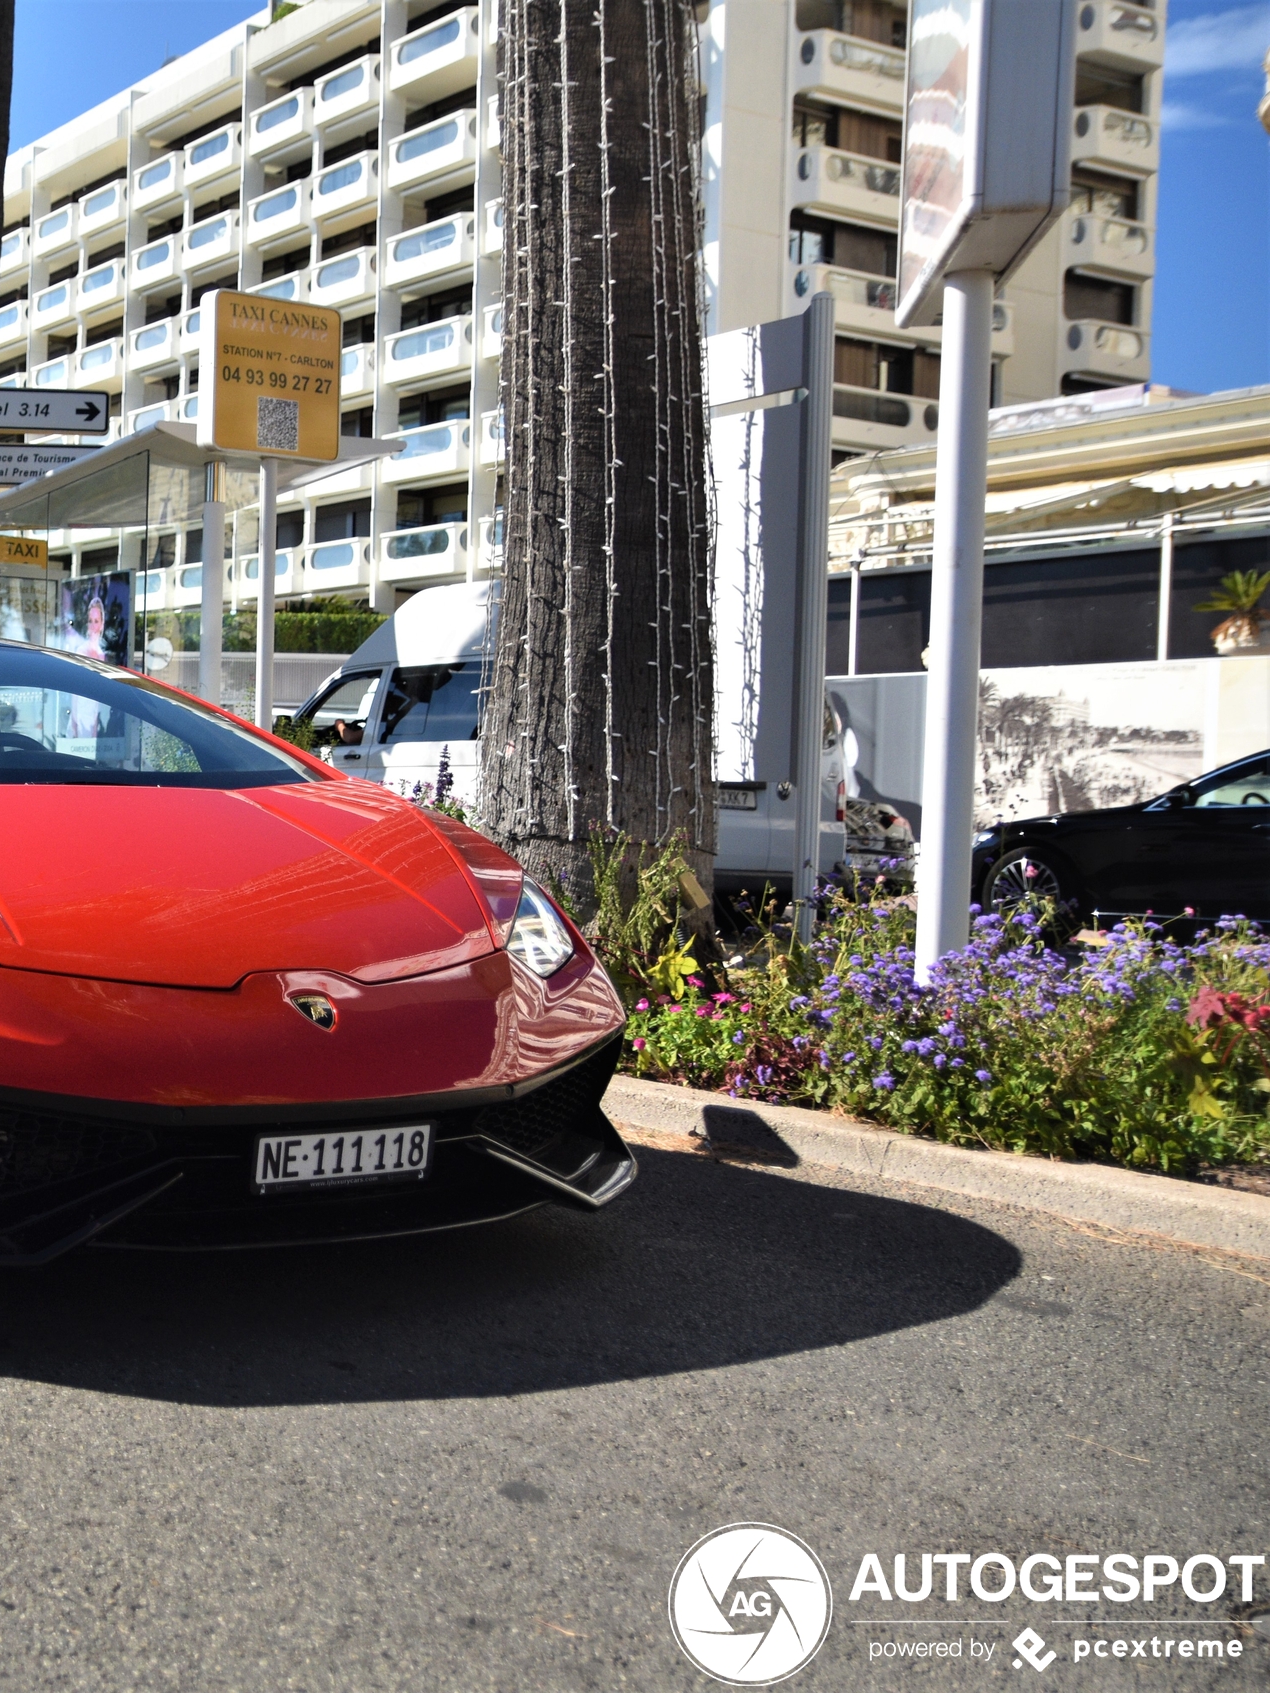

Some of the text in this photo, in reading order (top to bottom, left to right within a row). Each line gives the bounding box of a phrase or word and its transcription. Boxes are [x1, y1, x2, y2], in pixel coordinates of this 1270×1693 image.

[230, 302, 328, 331] TAXI CANNES
[223, 344, 263, 359] STATION
[266, 351, 281, 362] N°7
[290, 354, 334, 370] CARLTON
[222, 365, 332, 394] 04 93 99 27 27
[18, 402, 50, 417] 3.14
[16, 452, 28, 463] de
[33, 453, 76, 463] Tourisme
[12, 467, 47, 477] Premi
[5, 541, 39, 559] TAXI
